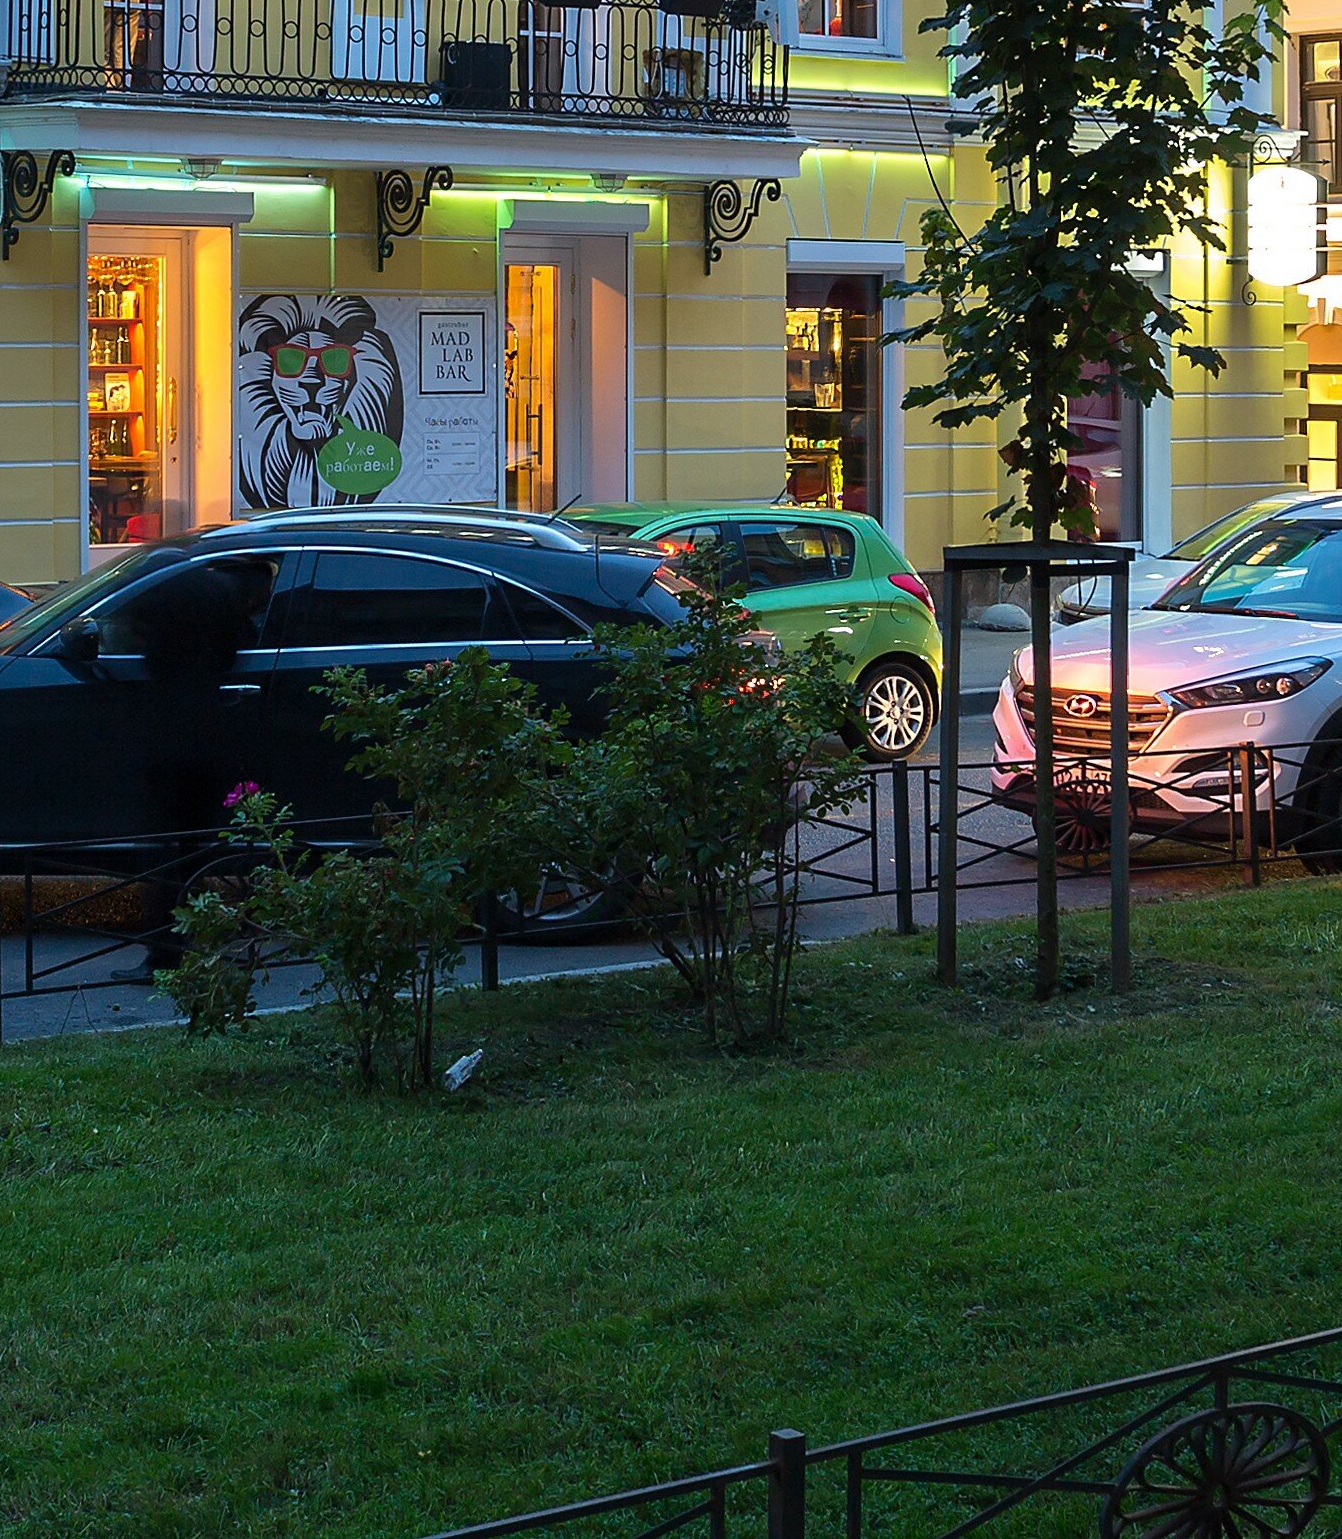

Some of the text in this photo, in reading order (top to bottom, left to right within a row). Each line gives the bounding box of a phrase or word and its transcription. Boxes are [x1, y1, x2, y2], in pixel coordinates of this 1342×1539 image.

[430, 331, 471, 346] MAD
[442, 347, 474, 363] LAB
[435, 364, 473, 383] BAR
[345, 441, 375, 456] Уже
[325, 456, 395, 478] работаем!
